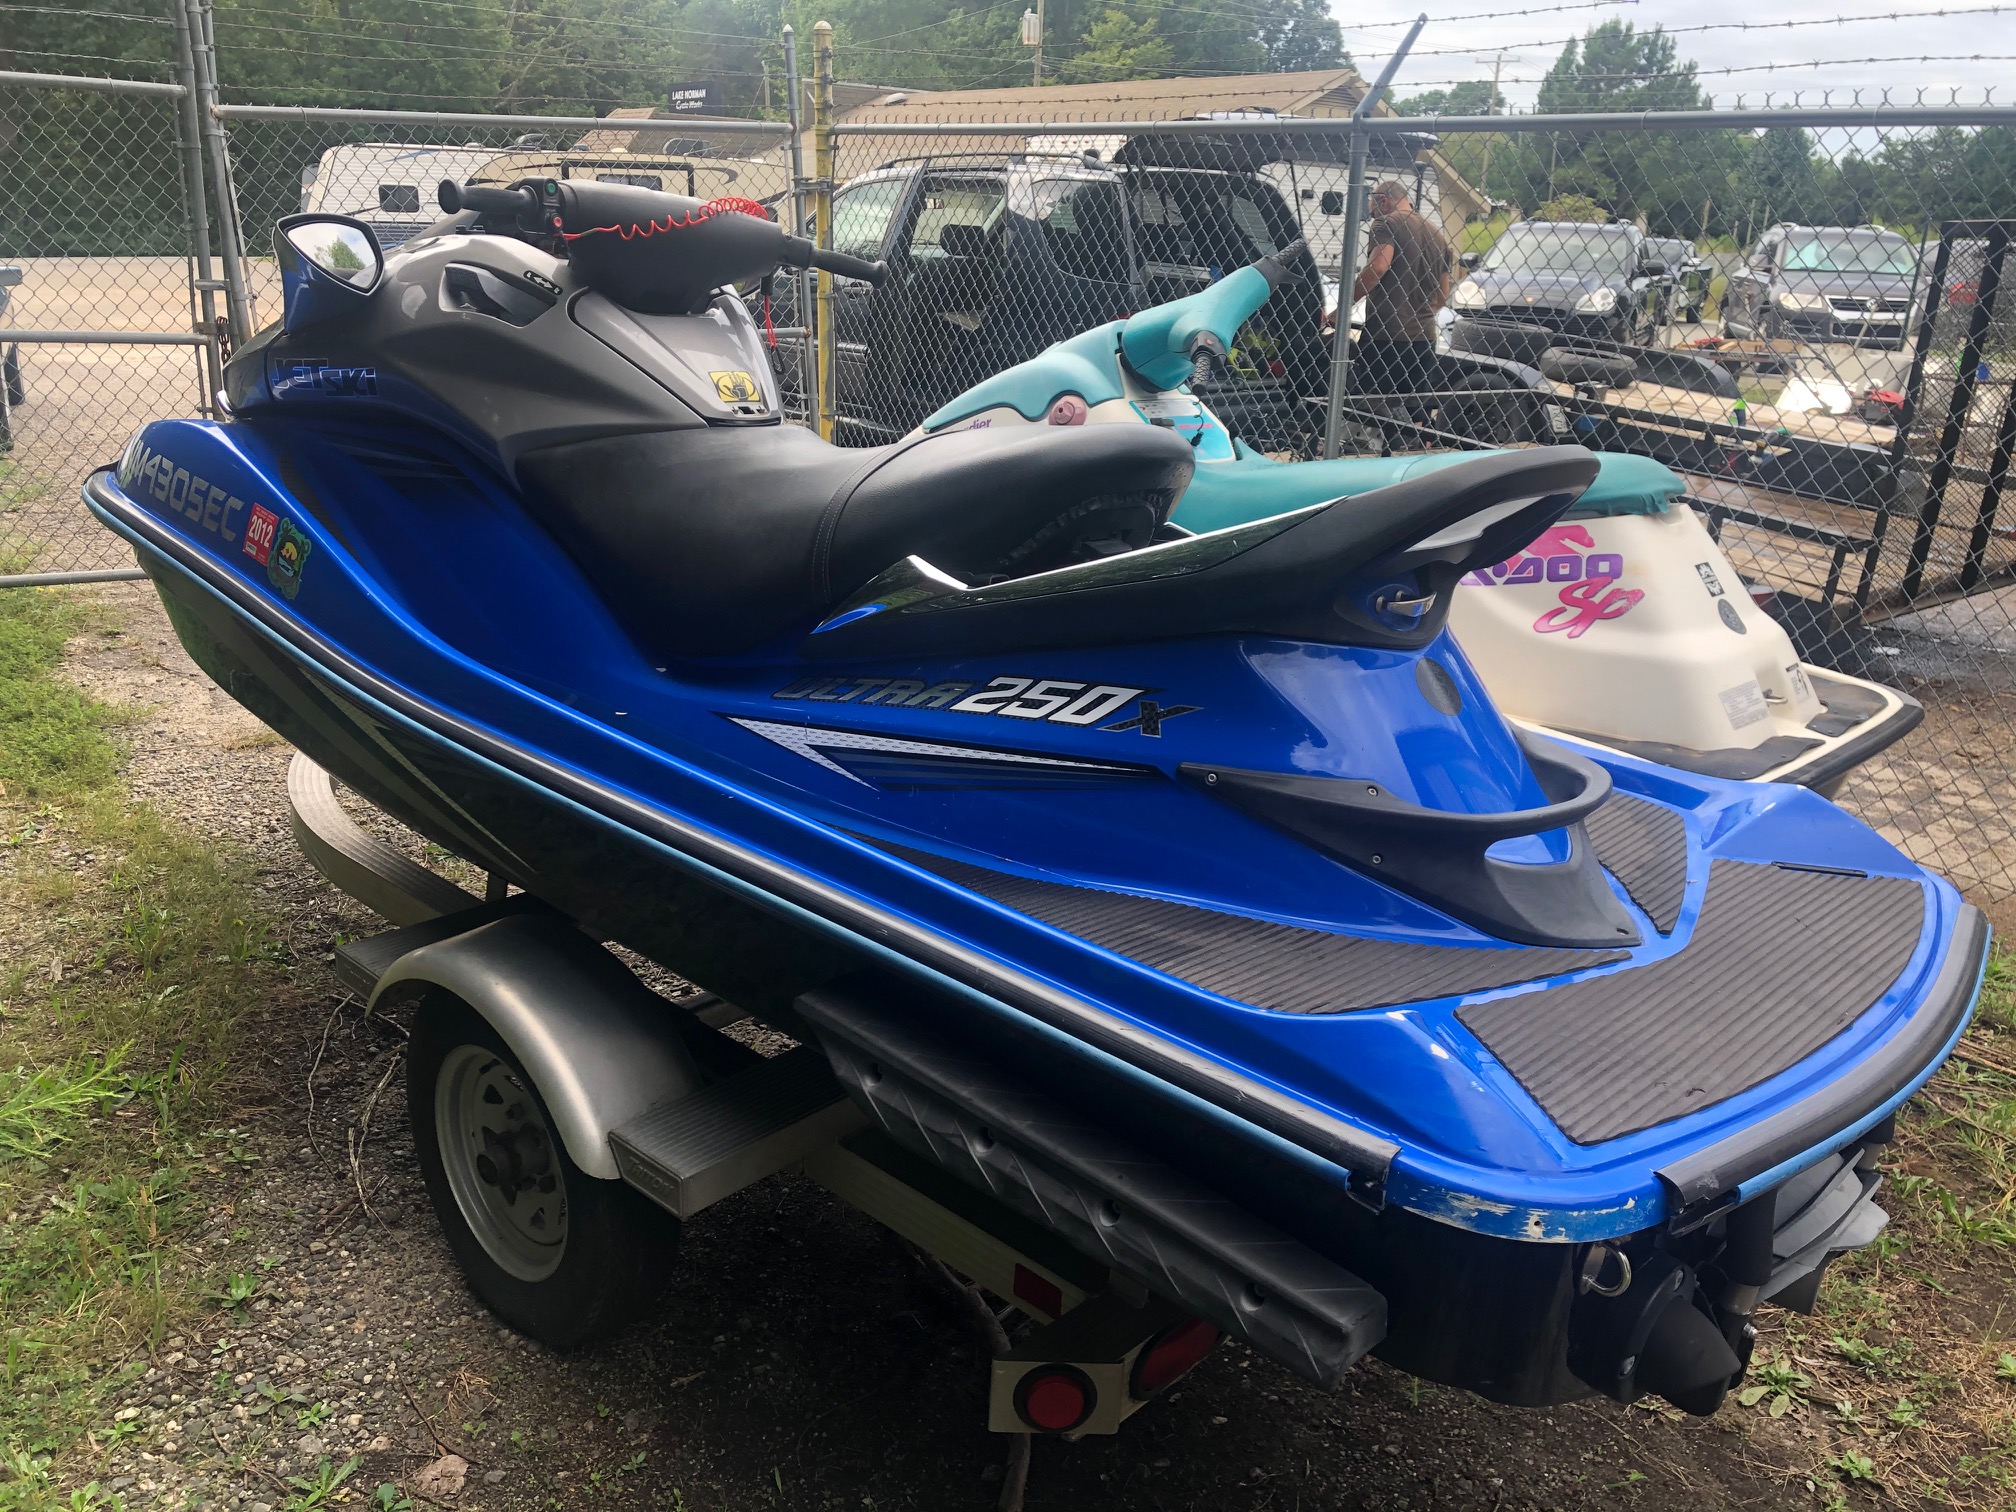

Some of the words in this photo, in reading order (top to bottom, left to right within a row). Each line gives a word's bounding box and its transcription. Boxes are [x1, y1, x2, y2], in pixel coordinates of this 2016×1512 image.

[672, 91, 684, 100] LAKE
[685, 89, 706, 99] NORMAN
[248, 515, 274, 549] 2012
[771, 676, 972, 709] ULTRA
